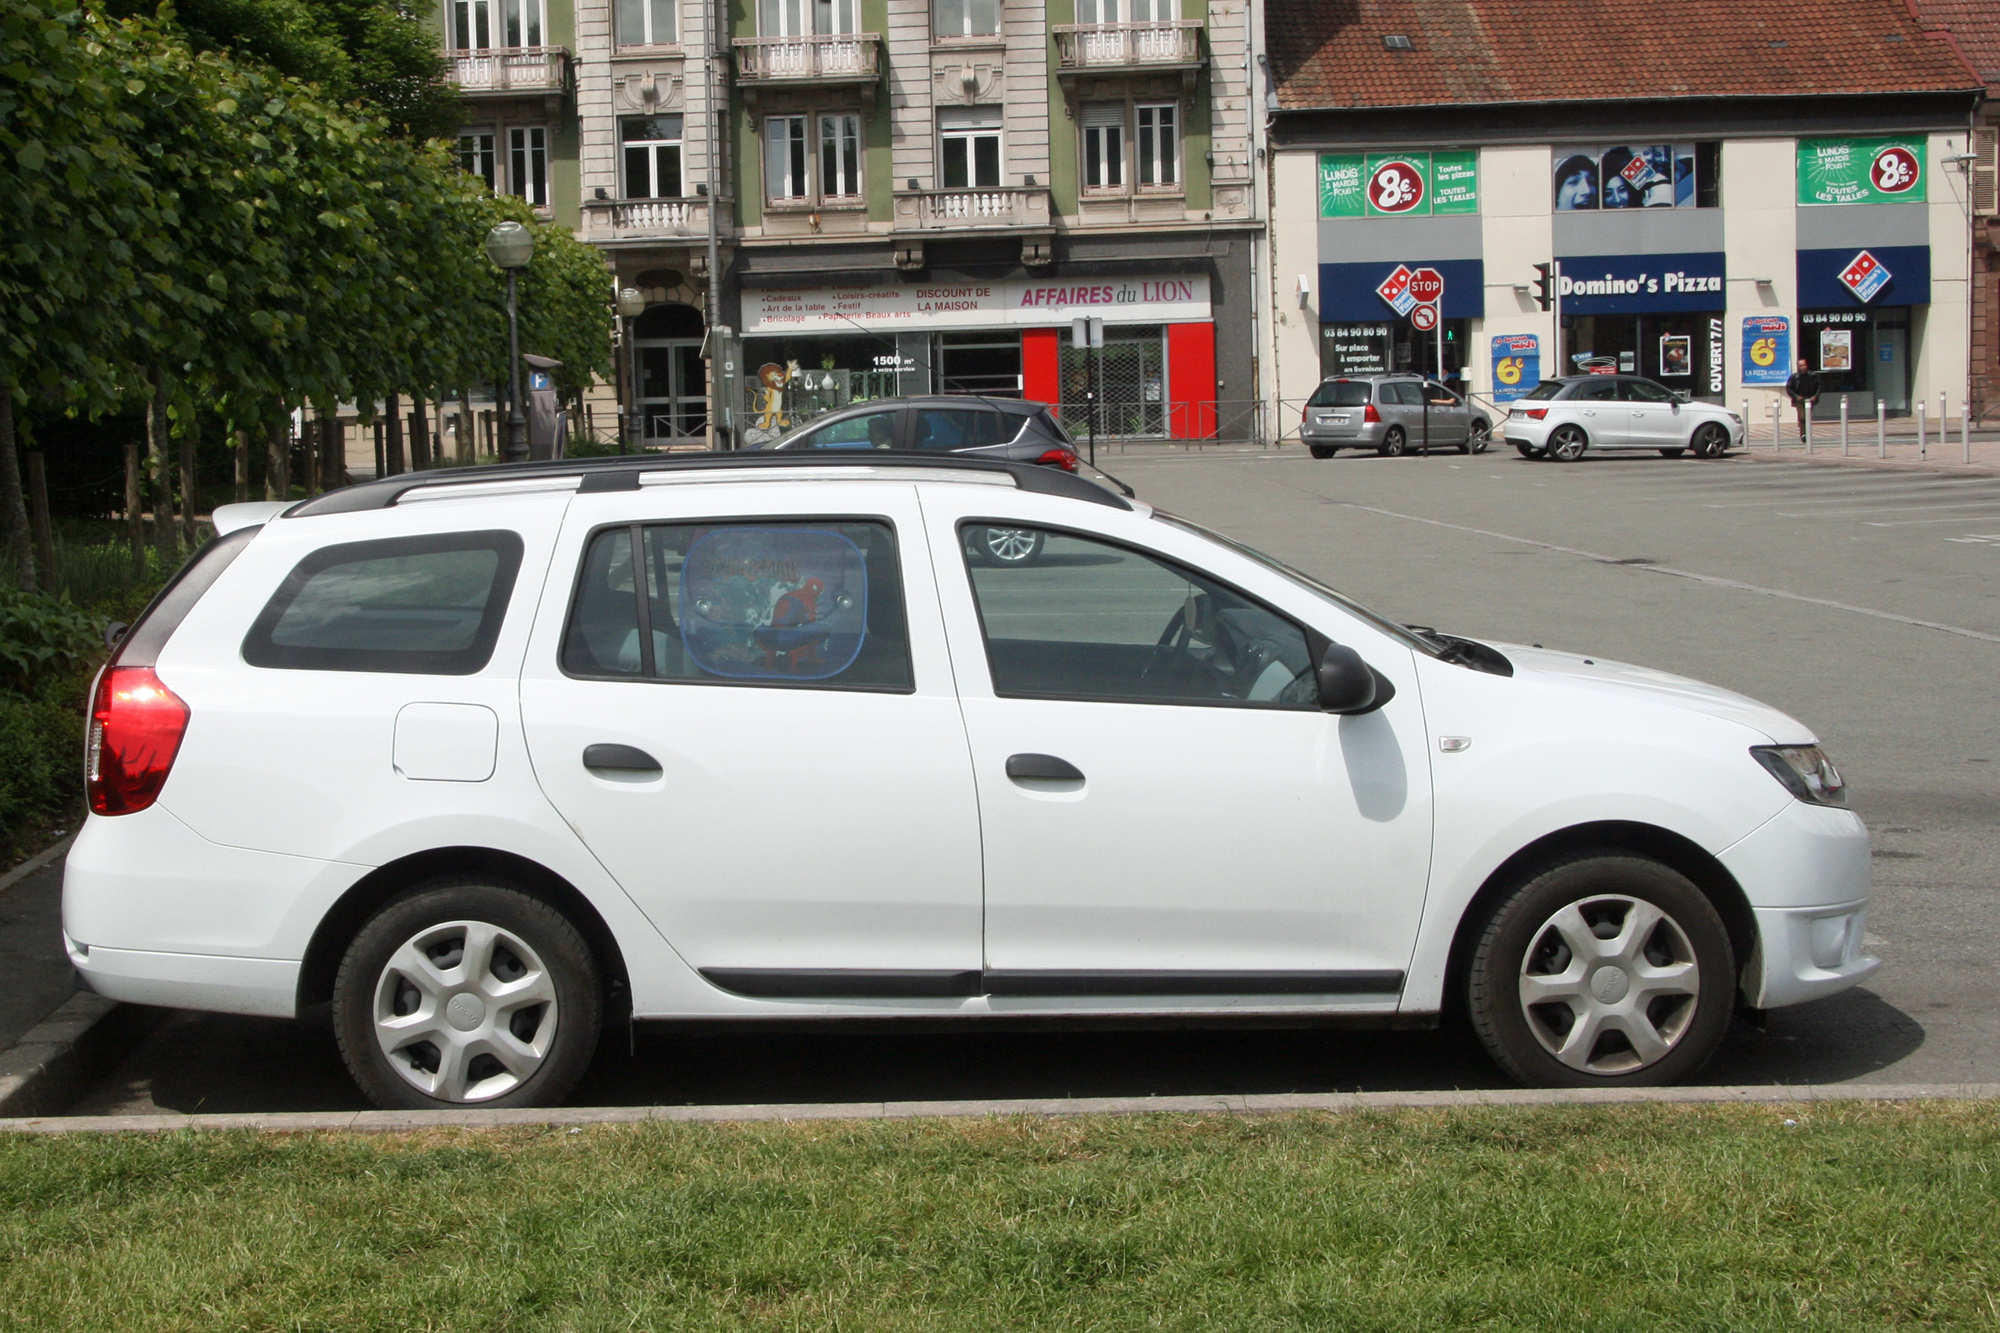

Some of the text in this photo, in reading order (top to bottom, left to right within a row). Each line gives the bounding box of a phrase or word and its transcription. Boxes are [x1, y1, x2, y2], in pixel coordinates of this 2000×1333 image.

[1438, 164, 1462, 173] Toutes
[1452, 170, 1475, 180] pizzas
[1440, 186, 1466, 196] TOUTES
[1826, 184, 1858, 194] TOUTES
[1434, 192, 1476, 204] LES TAILLES
[1816, 188, 1869, 202] LES TAILLES
[1560, 272, 1722, 296] Domino's Pizza
[1857, 269, 1882, 293] Domino's
[1412, 281, 1440, 292] STOP
[1862, 282, 1878, 299] Pizza
[766, 294, 802, 302] Cadeaux
[837, 291, 900, 300] Loisirs-créatifs
[916, 288, 991, 298] DISCOUNT DE
[1020, 280, 1193, 306] AFFAIRES du LION
[782, 304, 792, 312] de
[838, 302, 861, 310] Festif
[918, 301, 978, 311] LA MAISON
[766, 315, 806, 323] Bricolage
[1803, 312, 1866, 323] 03 84 90 80 90
[1324, 328, 1388, 337] 03 84 90 80 90
[1335, 344, 1368, 352] Sur place
[1340, 354, 1380, 363] à emporter
[1710, 318, 1722, 392] OUVERT 7/7
[872, 356, 901, 366] 1500
[1600, 969, 1620, 998] DACIA
